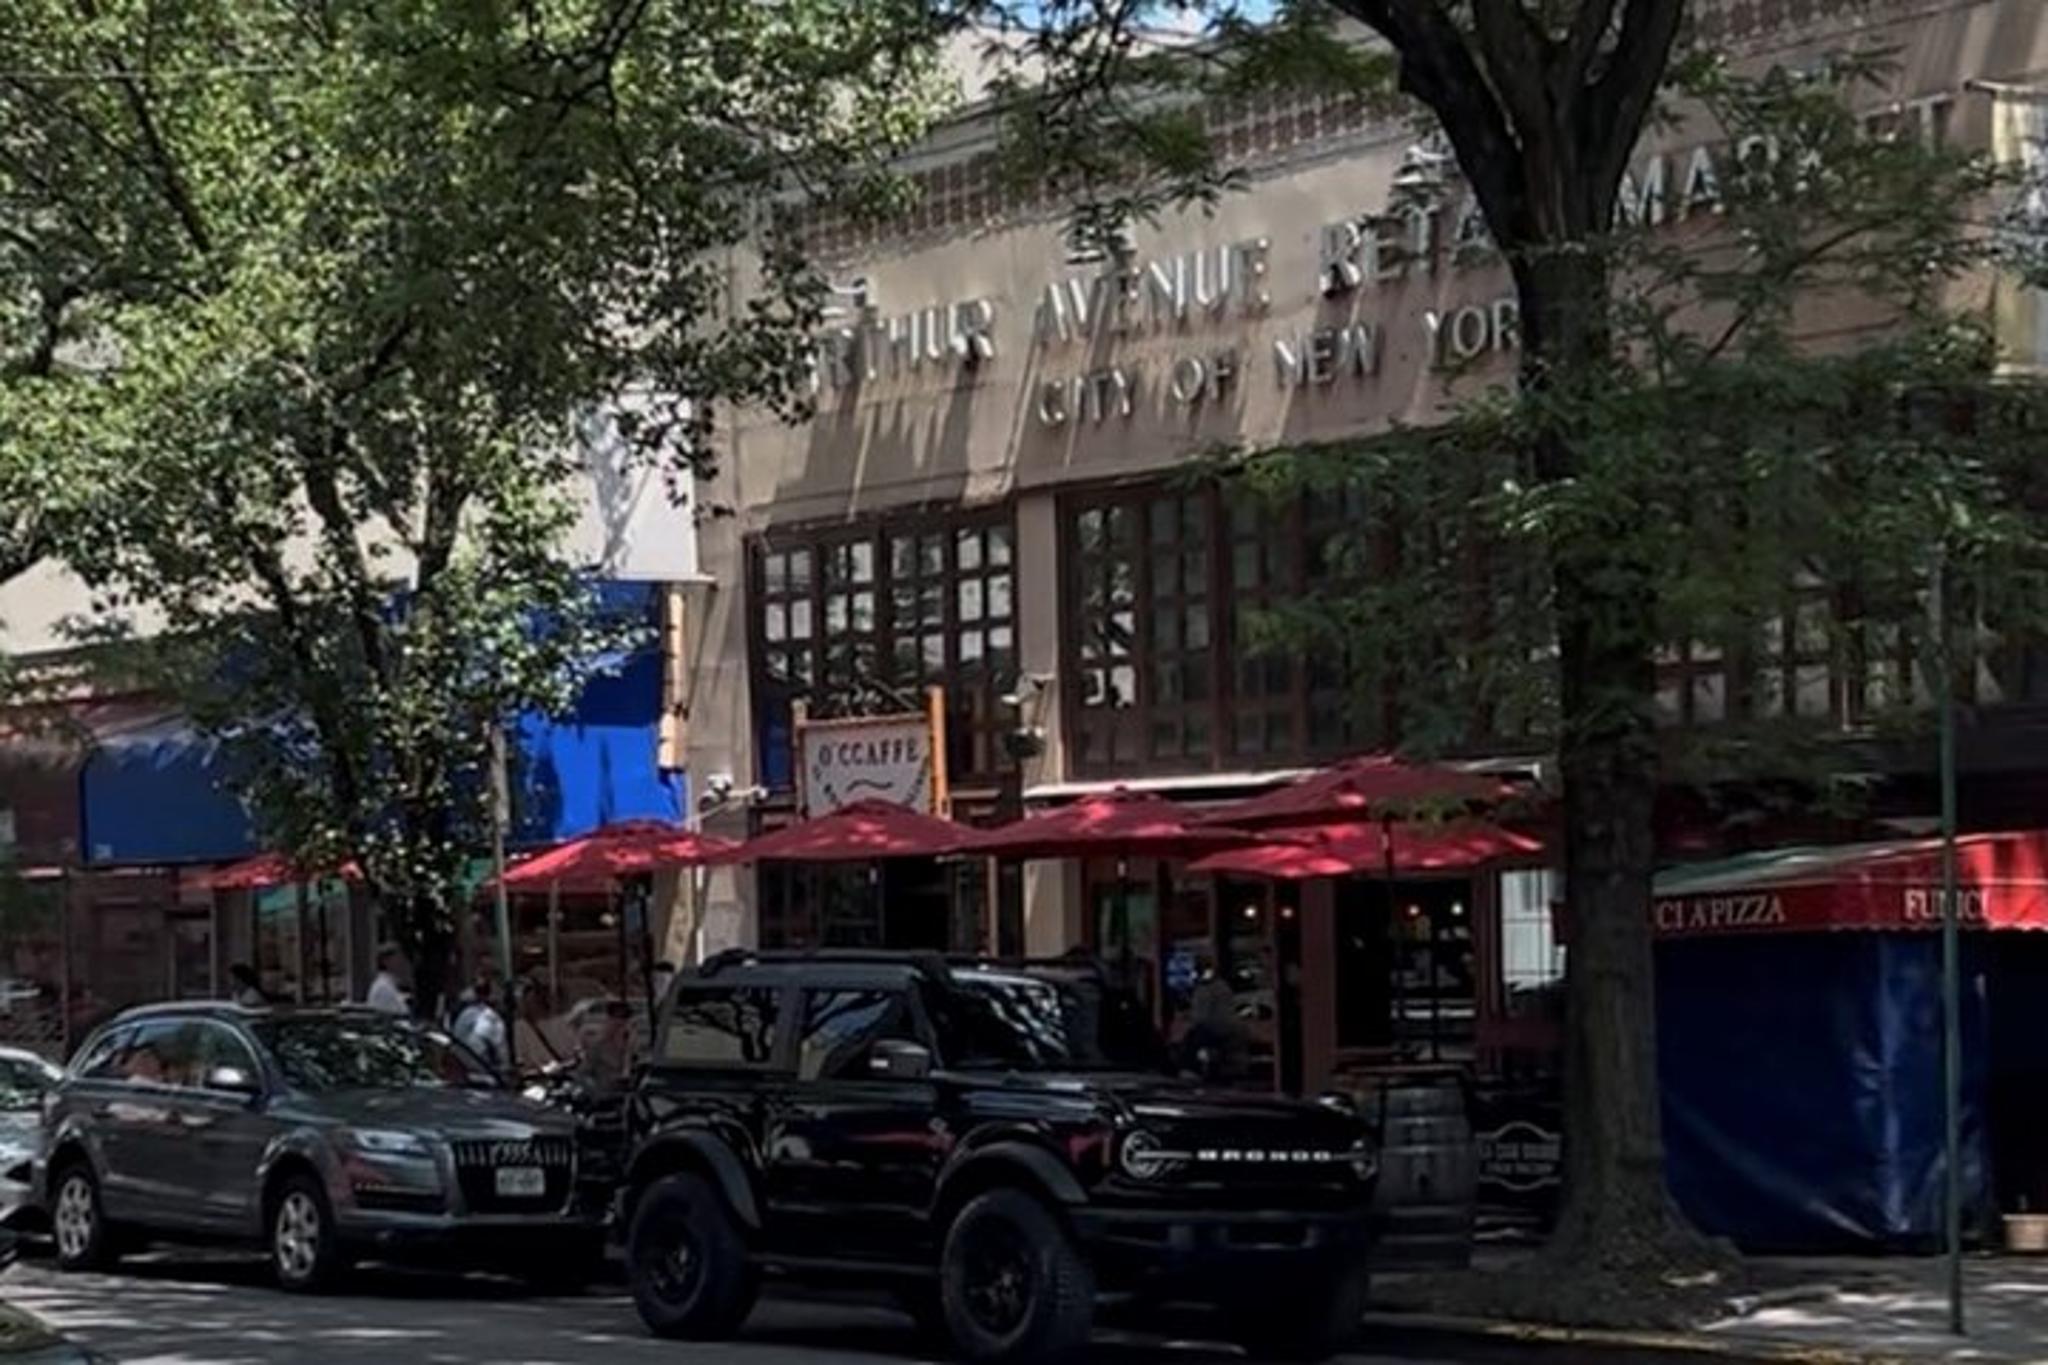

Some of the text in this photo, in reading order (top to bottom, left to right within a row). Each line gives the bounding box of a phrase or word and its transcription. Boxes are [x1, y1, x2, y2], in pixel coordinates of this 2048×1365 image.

[1038, 238, 1270, 345] AVENUE
[1318, 198, 1500, 296] RETA
[1039, 298, 1520, 426] CITY OF NEW YOR
[1711, 895, 1786, 927] PIZZA
